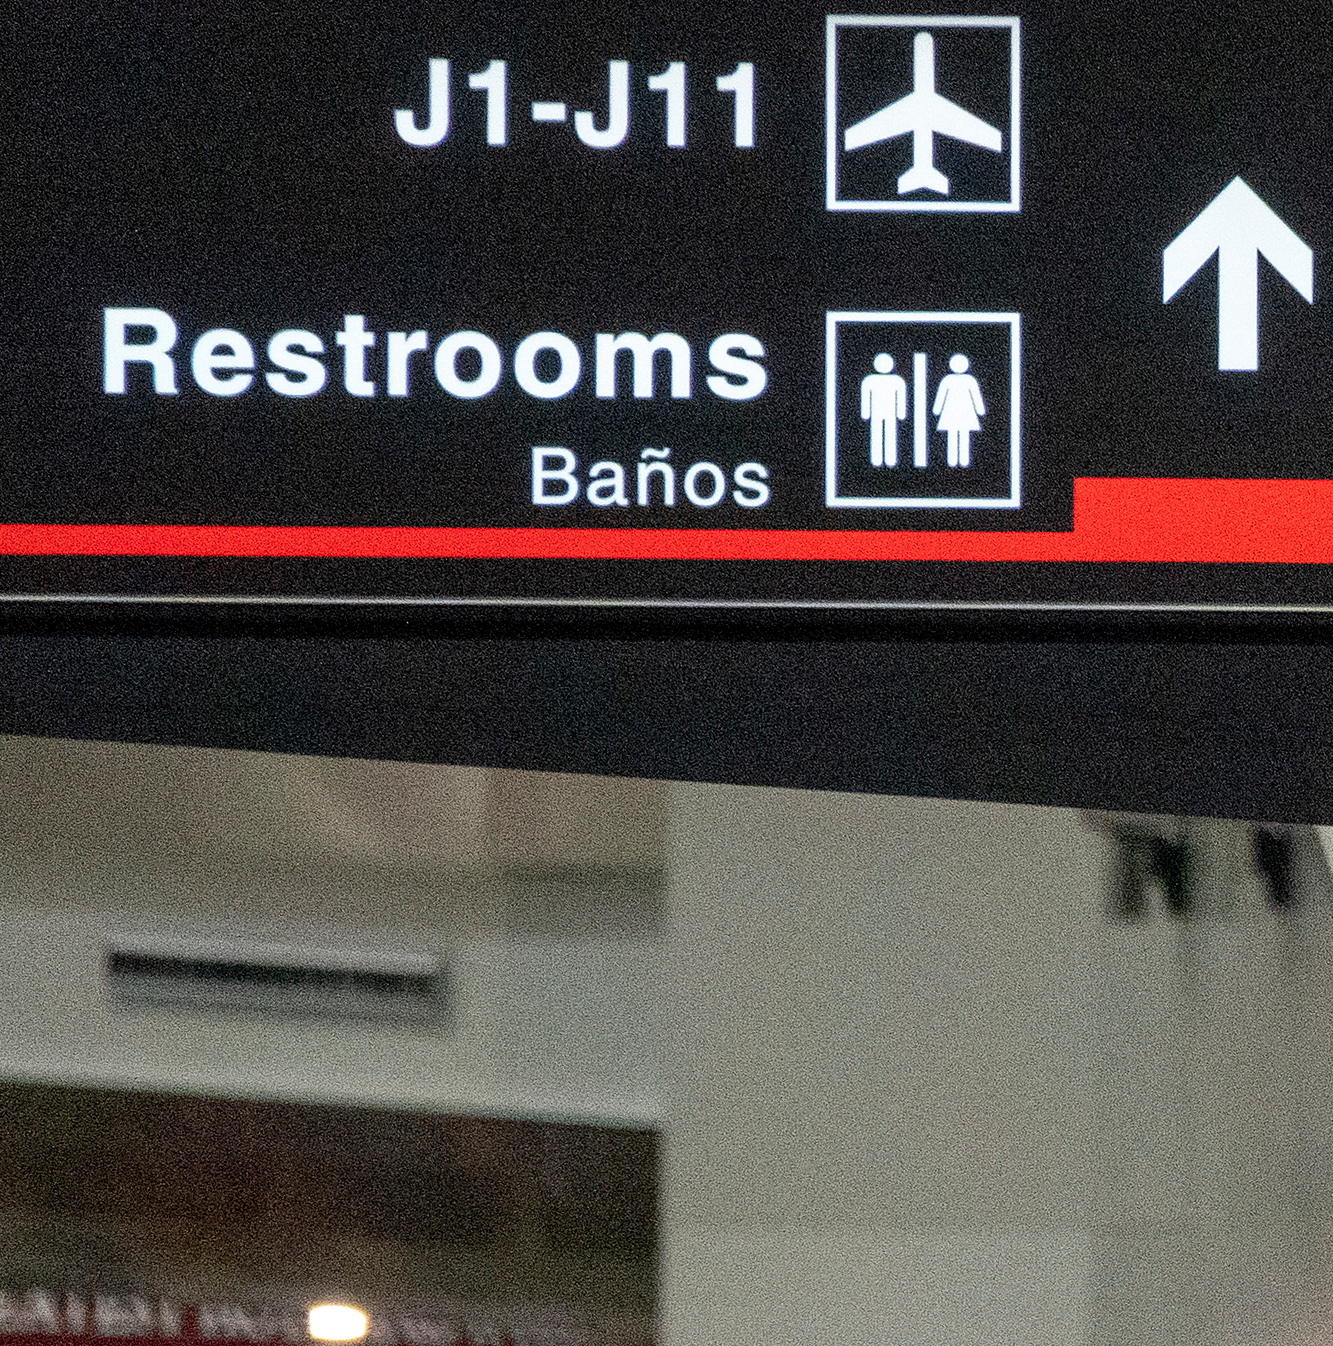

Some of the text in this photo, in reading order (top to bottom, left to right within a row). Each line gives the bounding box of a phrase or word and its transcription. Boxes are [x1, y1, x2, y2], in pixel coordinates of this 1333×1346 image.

[393, 57, 758, 150] J1-J11
[101, 306, 769, 403] Restrooms
[530, 445, 772, 510] Baños
